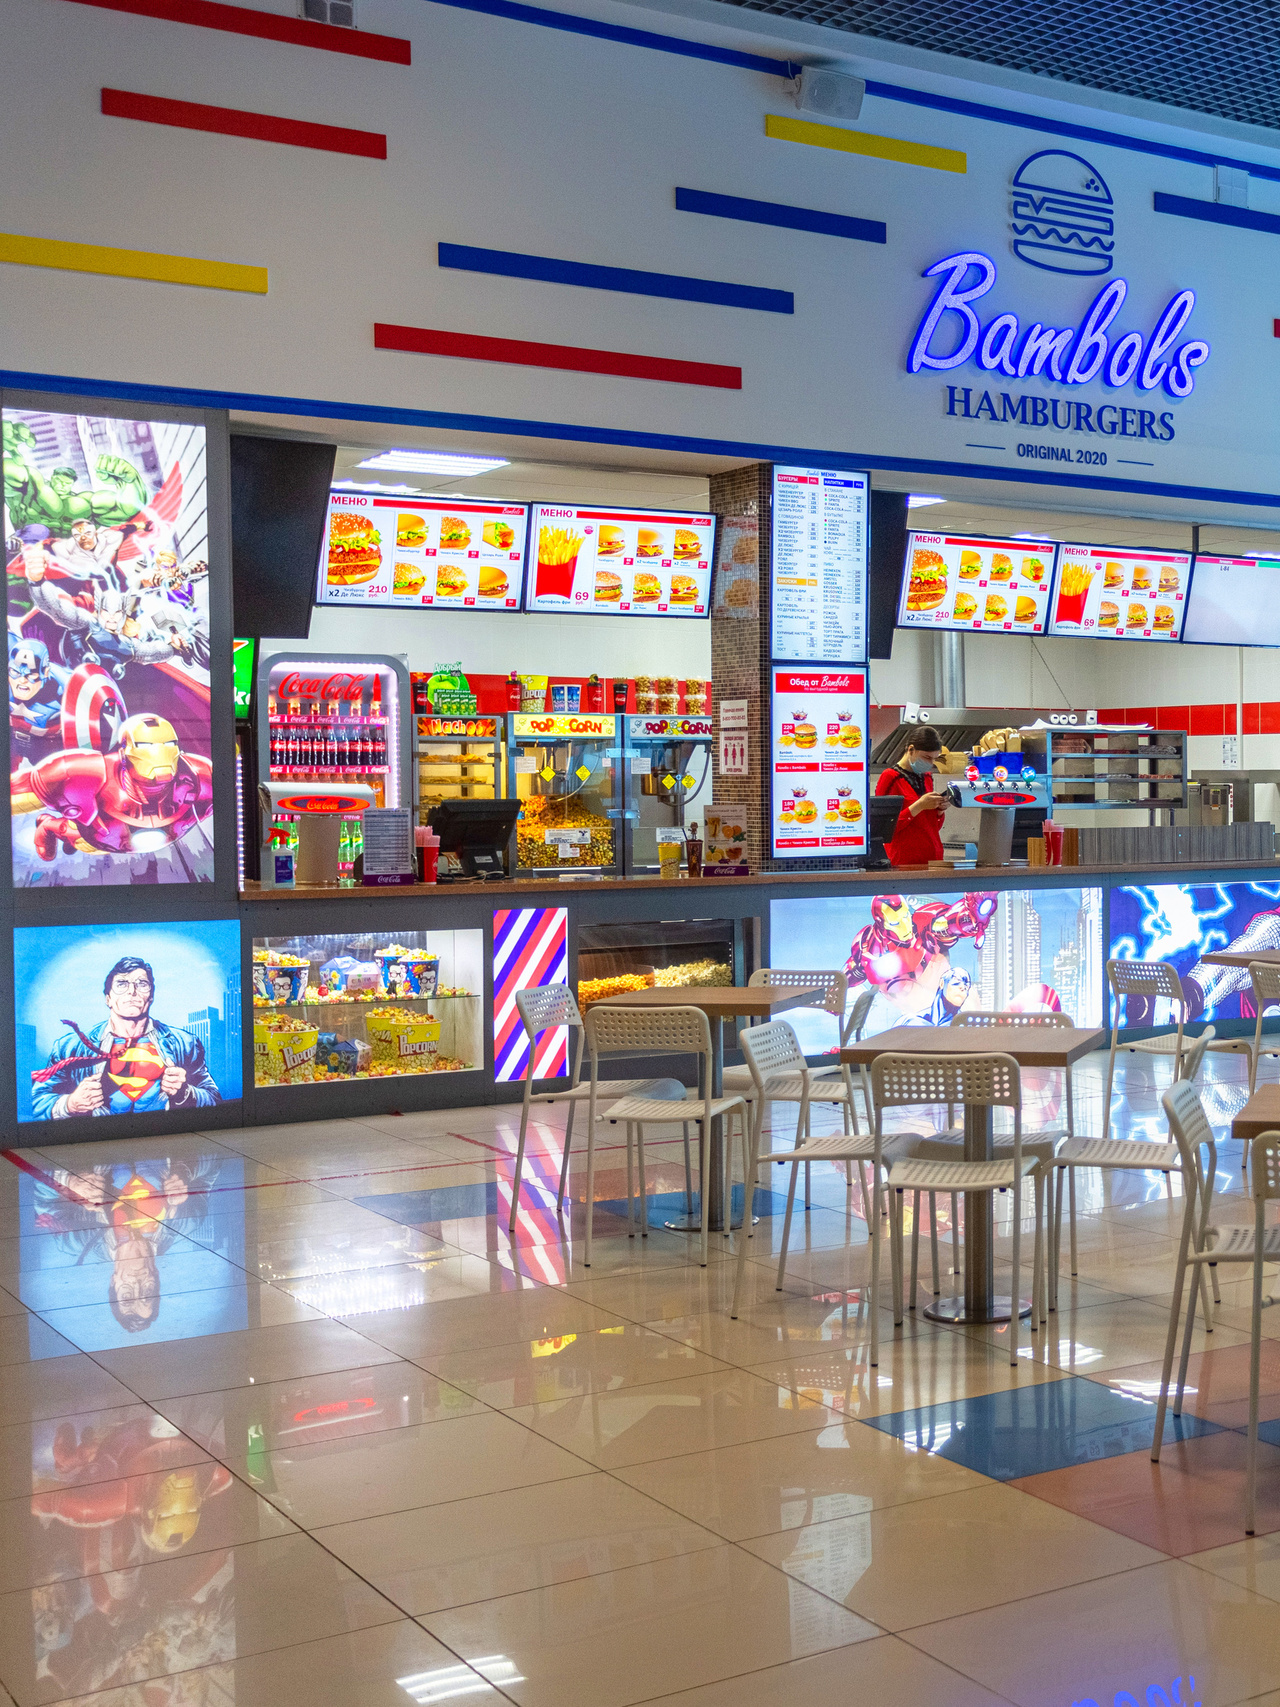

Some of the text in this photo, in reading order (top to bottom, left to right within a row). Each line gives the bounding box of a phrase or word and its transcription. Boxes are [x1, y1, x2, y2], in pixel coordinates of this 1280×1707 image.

[907, 251, 1211, 398] Bambols
[946, 384, 1175, 441] HAMBURGERS
[1017, 443, 1108, 465] ORIGINAL 2020
[331, 496, 368, 506] МЕНЮ
[540, 508, 573, 518] МЕНЮ
[915, 535, 942, 544] МЕНЮ
[1064, 547, 1089, 556] МЕНЮ
[368, 585, 388, 594] 210
[575, 592, 588, 601] 69
[935, 610, 950, 619] 210
[1084, 618, 1095, 627] 69
[278, 672, 369, 700] Coca-Cola
[790, 678, 810, 687] Обед
[820, 675, 851, 688] Bambols
[530, 718, 602, 736] POP CORN
[645, 719, 712, 735] POP CORN
[306, 798, 339, 810] Coca-Cola
[714, 867, 737, 875] Coca-Cola
[377, 875, 401, 884] Coca-Cola
